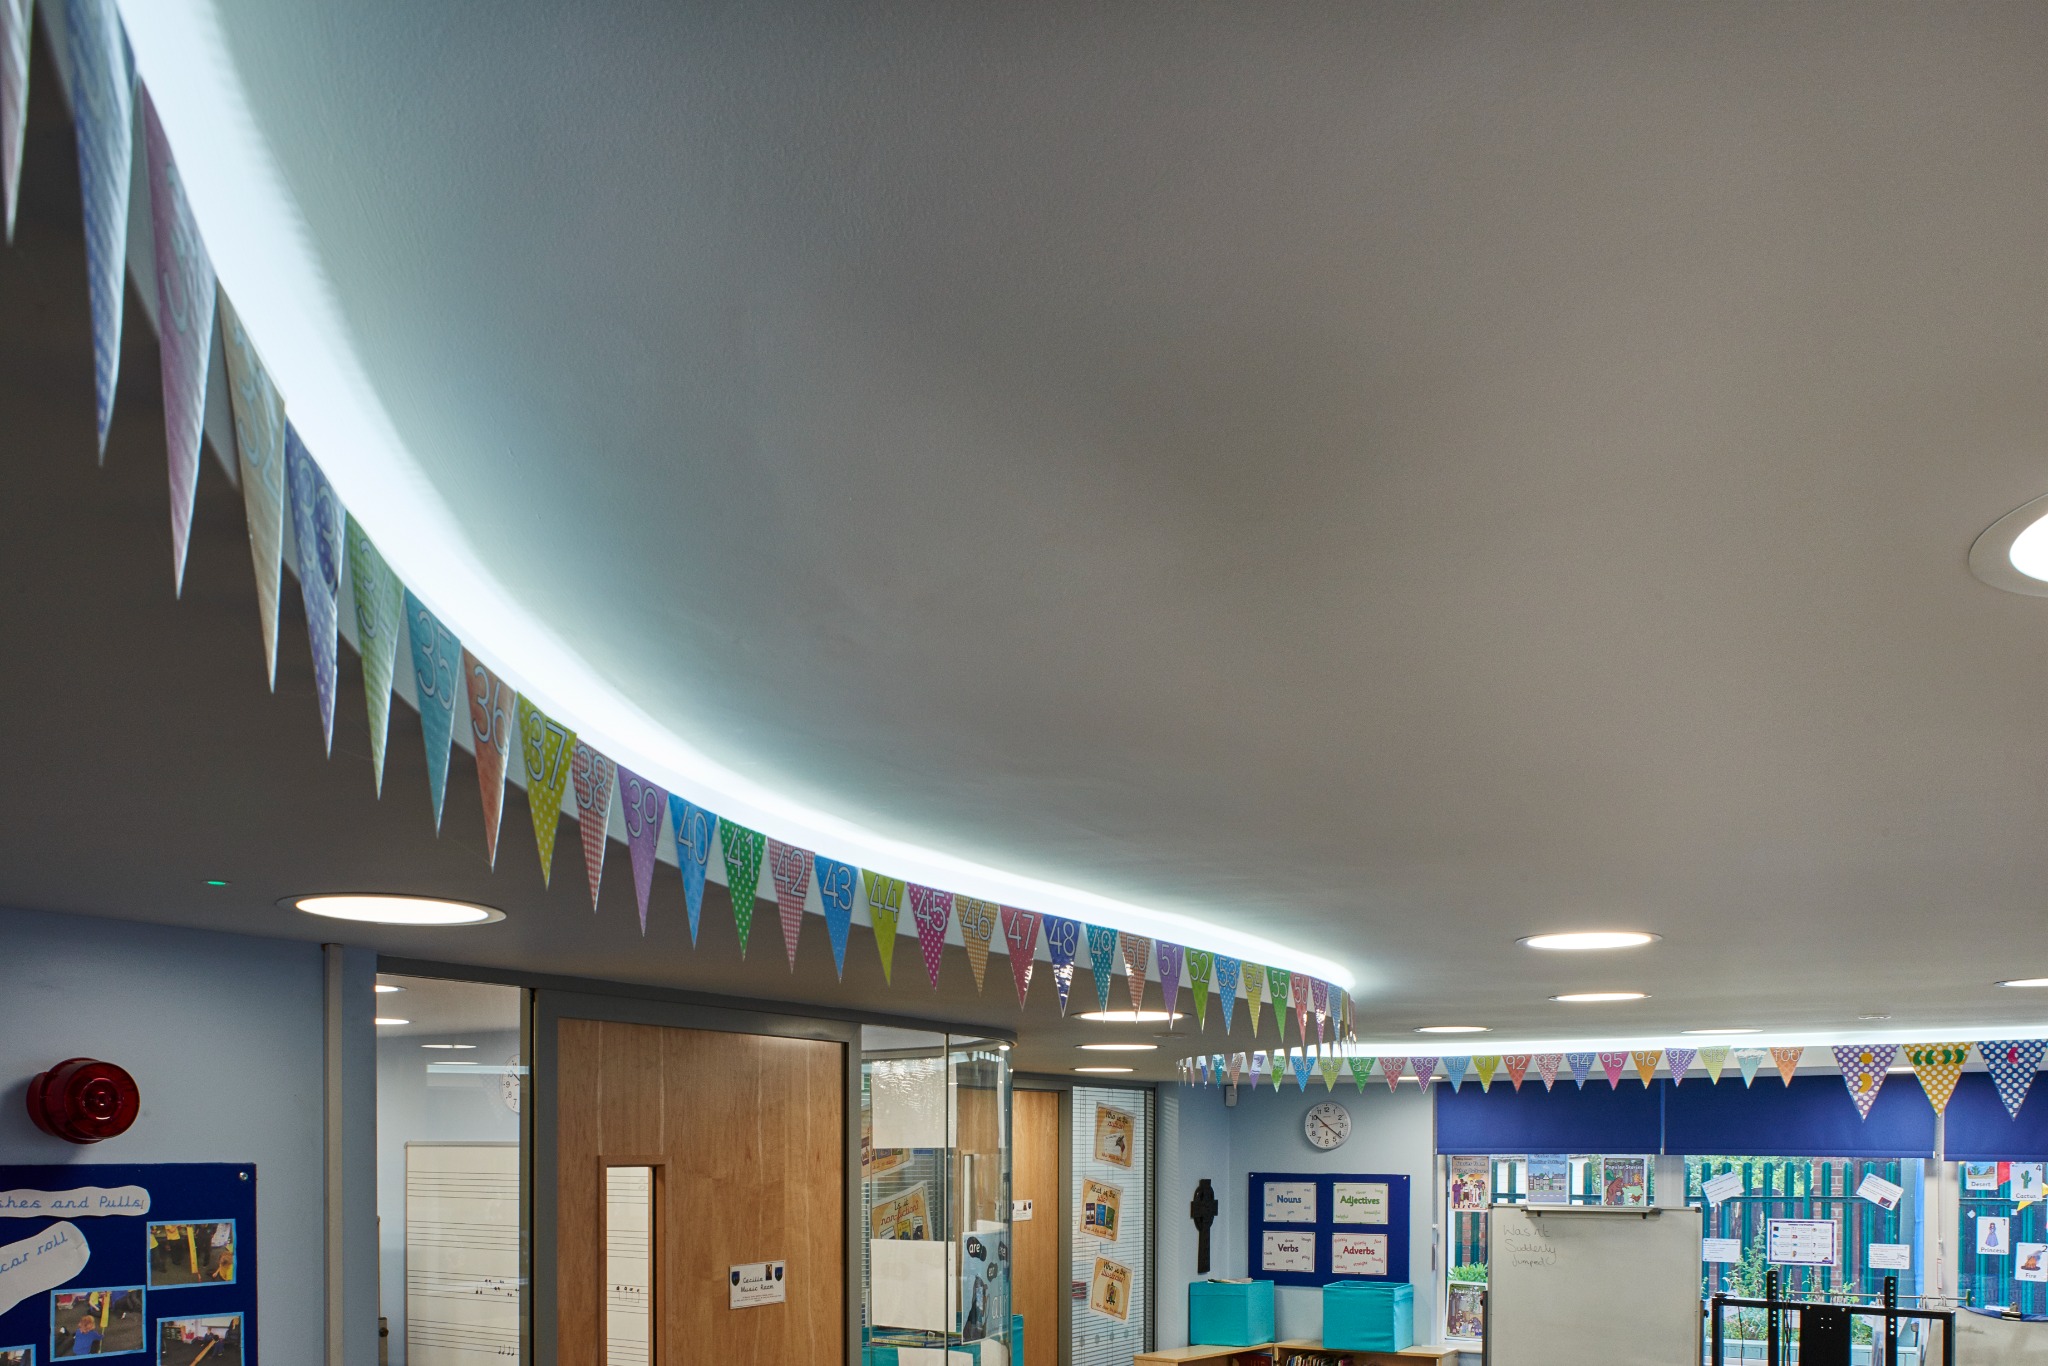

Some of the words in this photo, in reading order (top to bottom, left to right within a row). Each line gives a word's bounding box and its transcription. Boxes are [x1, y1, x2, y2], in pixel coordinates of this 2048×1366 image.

[417, 609, 453, 711] 35
[473, 665, 509, 755] 36
[527, 711, 567, 790] 37
[576, 745, 607, 818] 38
[627, 778, 658, 847] 39
[677, 804, 708, 865] 40
[727, 827, 755, 882] 41
[775, 845, 806, 898] 42
[823, 863, 851, 911] 43
[869, 875, 899, 923] 44
[916, 888, 947, 932] 45
[962, 899, 991, 941] 46
[1008, 911, 1034, 950] 47
[1049, 918, 1075, 957] 48
[1091, 928, 1113, 964] 49
[1126, 936, 1147, 971] 50
[1161, 943, 1178, 978] 51
[1190, 950, 1209, 984] 52
[1219, 956, 1237, 989] 53
[1245, 963, 1262, 992] 54
[1272, 970, 1287, 999] 55
[1294, 976, 1307, 1004] 56
[1314, 980, 1326, 1007] 57
[1353, 1057, 1371, 1072] 87
[1383, 1057, 1403, 1071] 88
[1415, 1057, 1434, 1072] 89
[1447, 1057, 1466, 1072] 90
[1477, 1056, 1494, 1070] 91
[1505, 1055, 1526, 1070] 92
[1538, 1054, 1558, 1069] 93
[1569, 1054, 1590, 1068] 94
[1602, 1053, 1623, 1068] 95
[1635, 1051, 1657, 1066] 96
[1669, 1049, 1691, 1064] 97
[1703, 1047, 1725, 1063] 98
[1773, 1049, 1800, 1062] 100
[2036, 1164, 2042, 1172] 4
[51, 1196, 89, 1208] and
[1277, 1195, 1302, 1204] Nouns
[1340, 1195, 1380, 1206] Adjectives
[0, 1252, 29, 1274] car
[37, 1231, 68, 1255] roll
[969, 1243, 981, 1254] are
[1277, 1244, 1299, 1252] Verbs
[1343, 1246, 1375, 1255] Adverbs
[2041, 1245, 2048, 1253] 2
